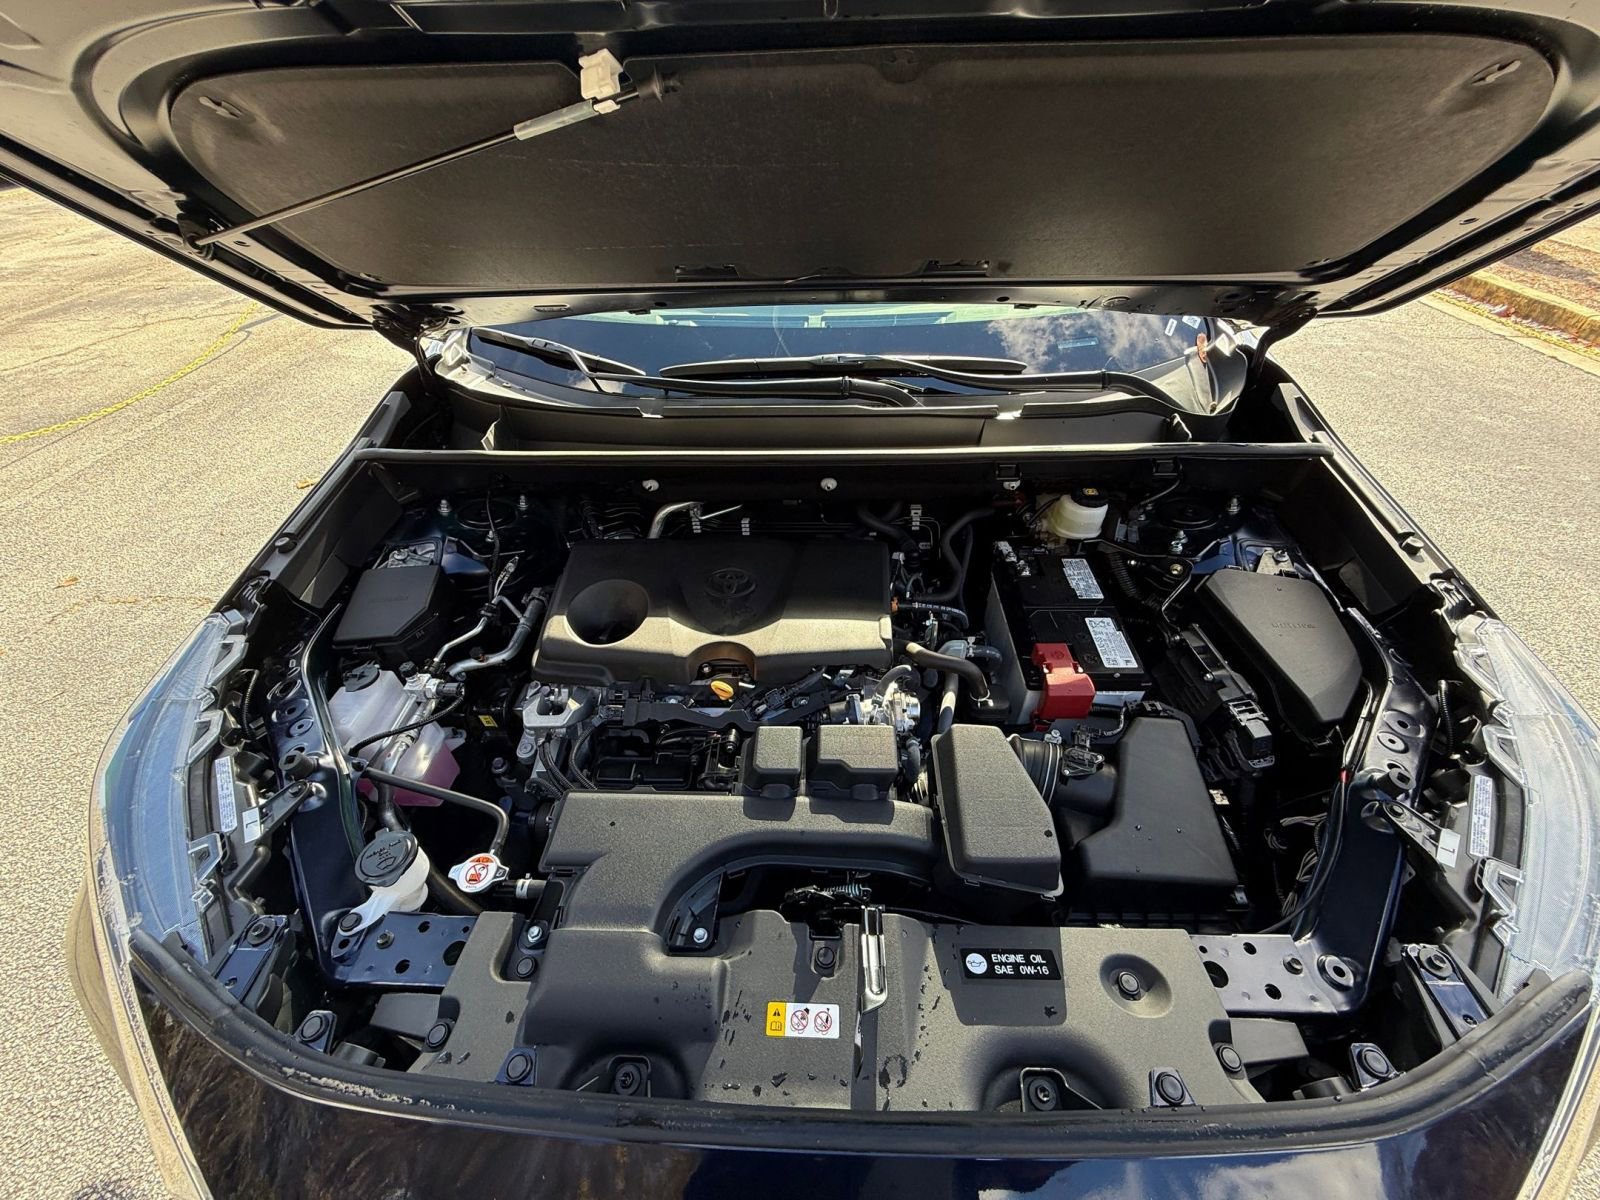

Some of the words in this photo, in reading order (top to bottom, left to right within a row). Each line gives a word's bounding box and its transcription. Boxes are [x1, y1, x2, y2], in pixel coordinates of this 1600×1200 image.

[991, 954, 1025, 963] ENGINE
[1030, 954, 1046, 963] OIL
[994, 965, 1014, 974] SAE
[1020, 965, 1049, 975] 0W-16
